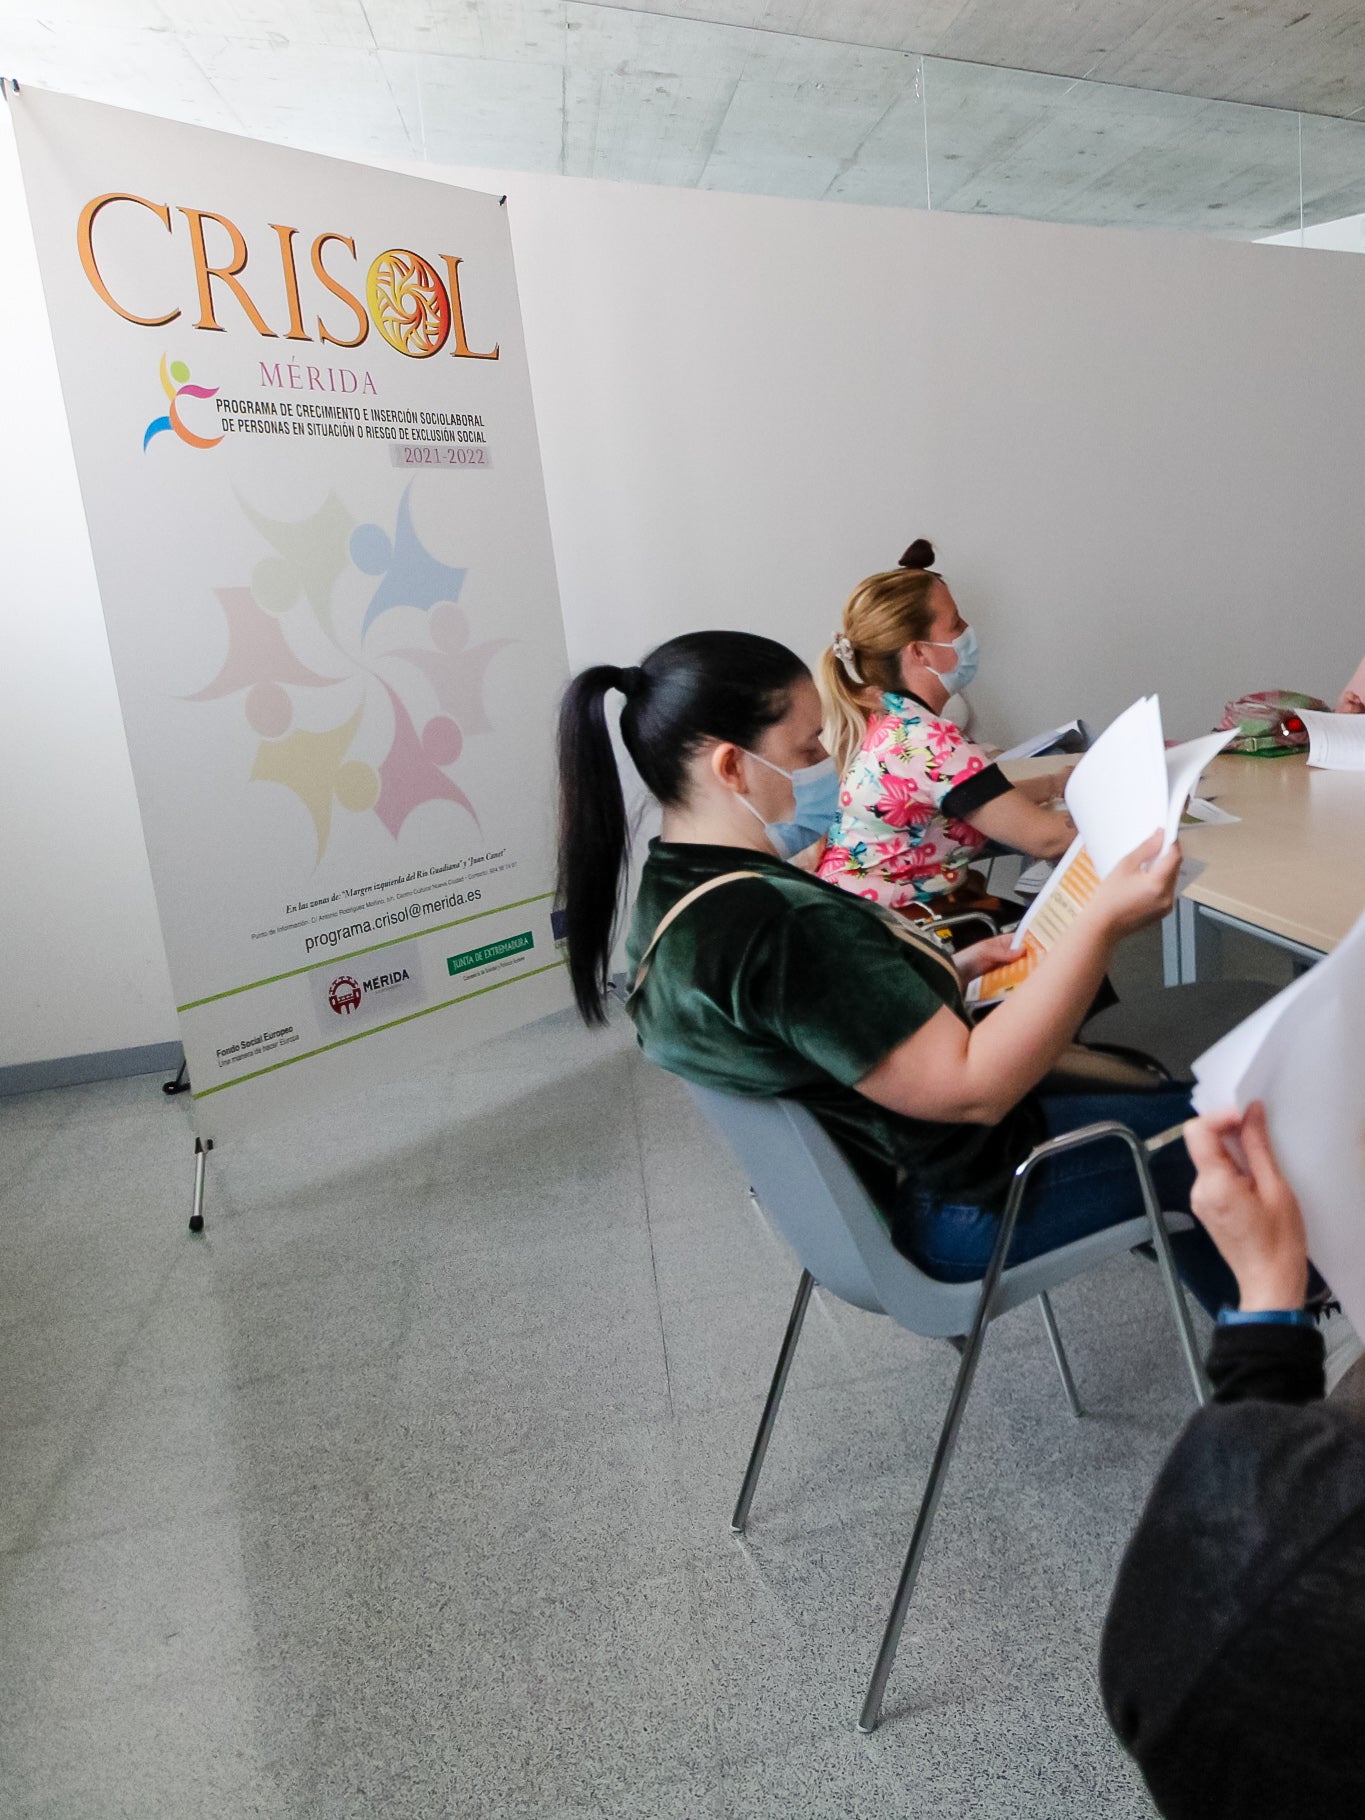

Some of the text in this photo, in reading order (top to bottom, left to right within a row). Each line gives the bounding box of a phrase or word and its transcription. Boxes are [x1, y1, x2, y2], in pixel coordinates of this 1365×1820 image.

[77, 192, 499, 360] CRISOL
[259, 356, 378, 395] MÉRIDA
[216, 398, 485, 427] PROGRAMA DE CRECIMIENTO E INSERCIÓN SOCIOLABORAL
[222, 418, 486, 443] DE PERSONAS EN SITUACIÓN O RIESGO DE EXCLUSIÓN SOCIAL
[404, 447, 485, 464] 2021-2022
[286, 904, 298, 914] En
[298, 901, 308, 911] las
[309, 897, 329, 908] zonas
[405, 871, 416, 882] del
[305, 888, 482, 953] programa.crisol@merida.es
[453, 955, 474, 971] JUNTA
[474, 951, 483, 962] DE
[484, 937, 529, 959] EXTREMADURA
[216, 1025, 294, 1058] Fondo Social Europeo
